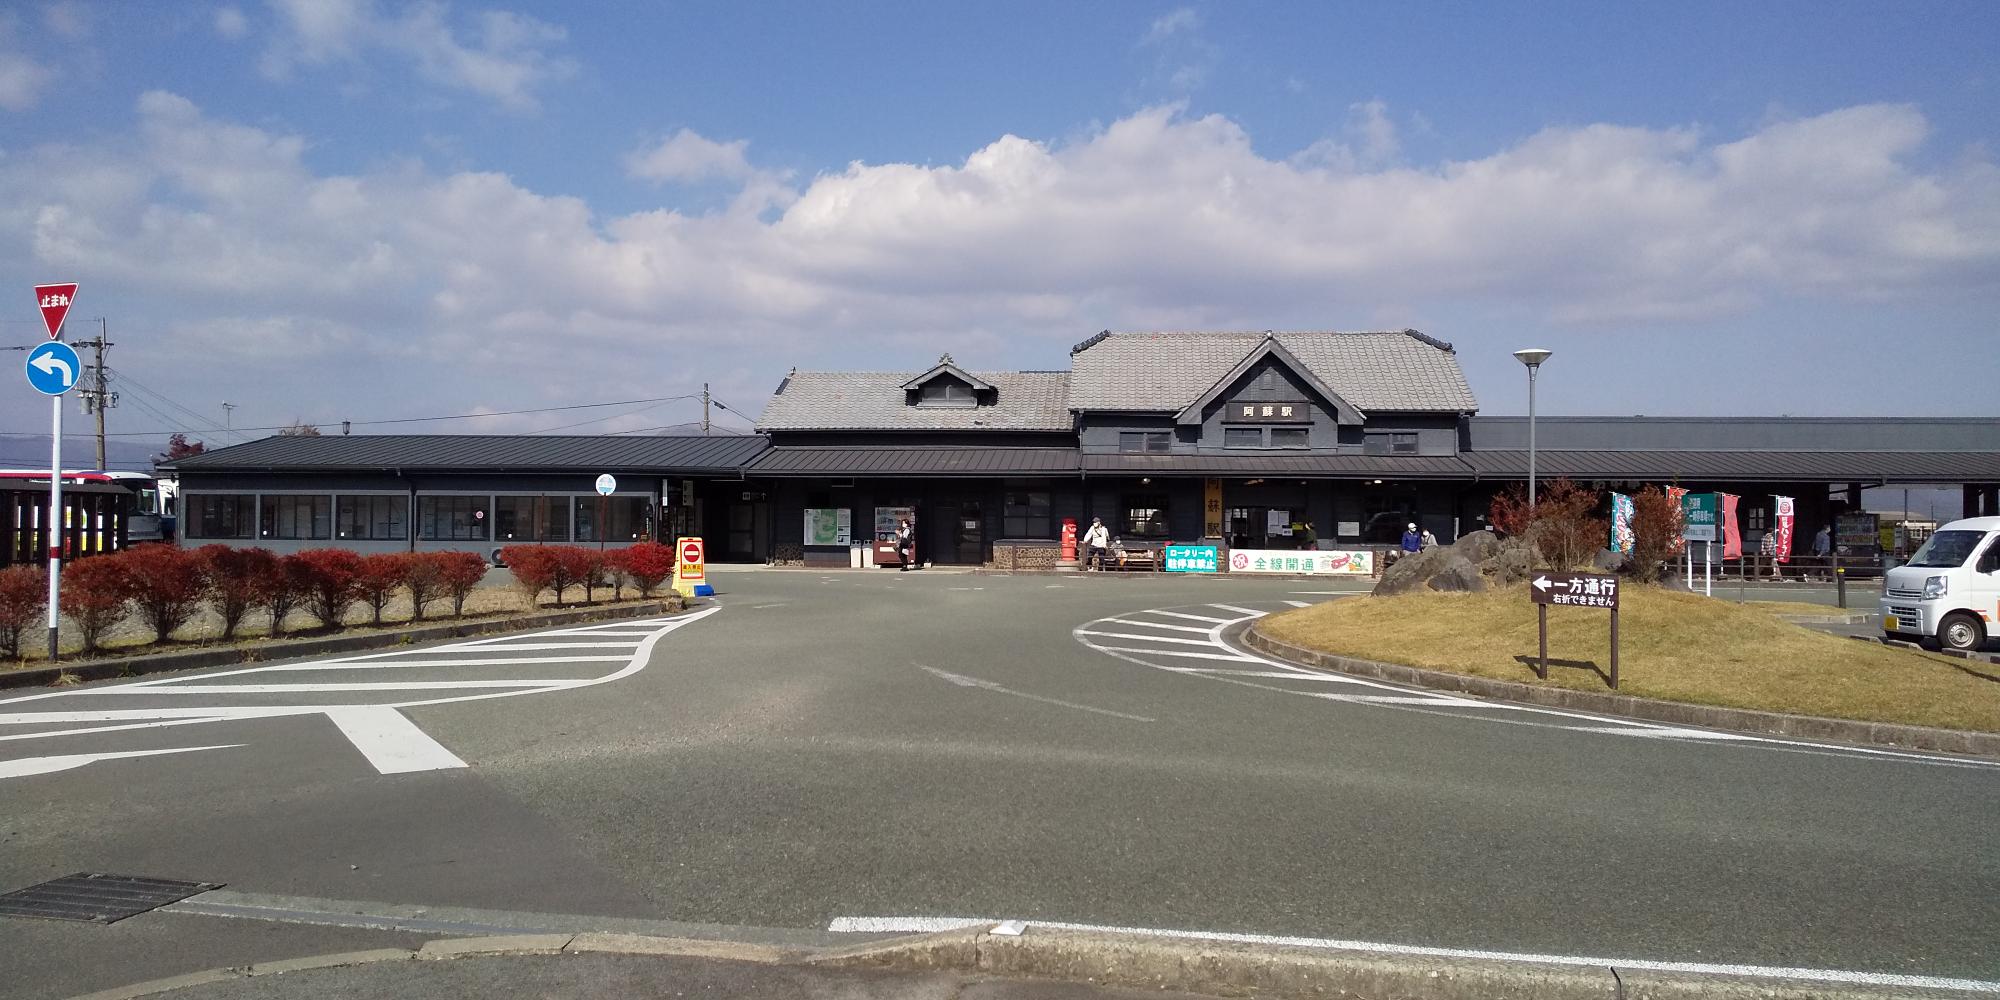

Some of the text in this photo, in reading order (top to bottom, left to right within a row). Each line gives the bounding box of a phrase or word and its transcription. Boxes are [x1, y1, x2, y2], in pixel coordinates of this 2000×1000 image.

[41, 294, 69, 307] 止まれ
[1243, 406, 1293, 417] 阿蘇駅
[1169, 549, 1214, 558] ロータリー内
[1232, 553, 1249, 570] 祝
[1254, 557, 1314, 571] 全線開通
[1554, 577, 1616, 596] 一方通行
[1553, 593, 1615, 607] 右折できません
